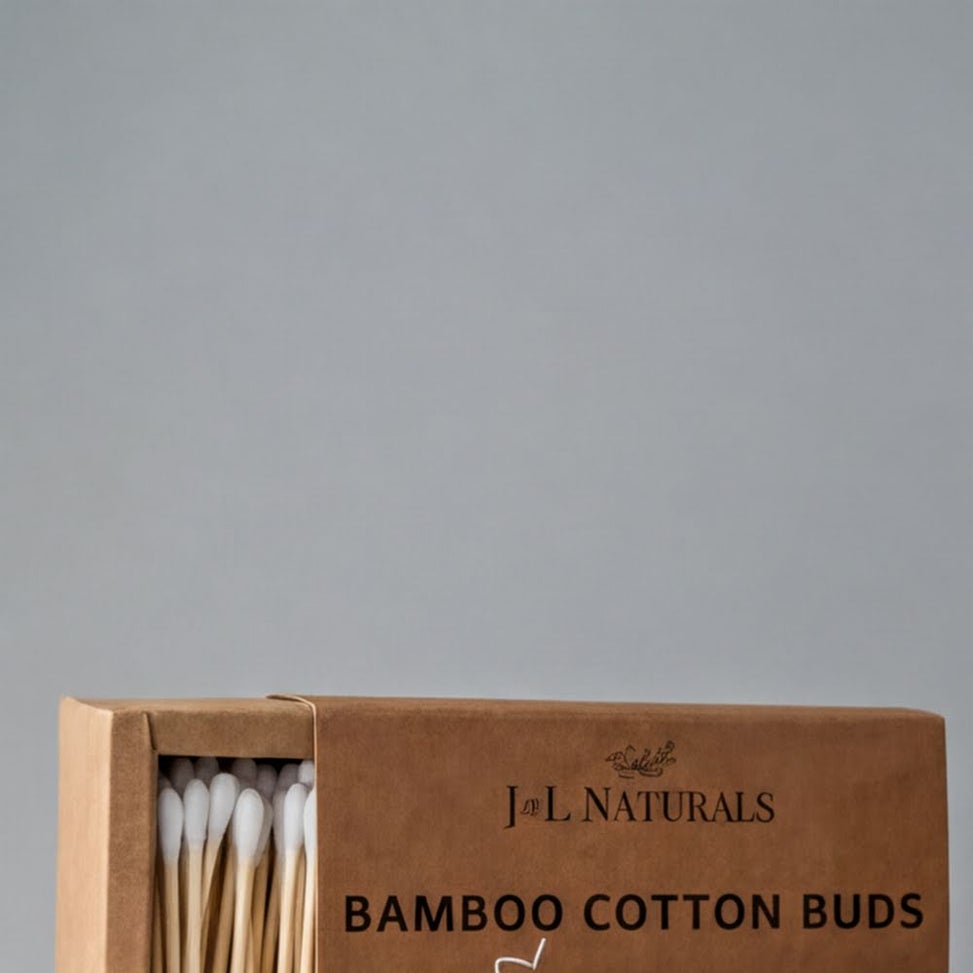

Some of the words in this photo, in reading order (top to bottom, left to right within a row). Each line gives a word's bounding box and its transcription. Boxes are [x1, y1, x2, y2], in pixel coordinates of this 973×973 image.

[581, 786, 775, 824] NATURALS
[344, 893, 564, 933] BAMBOO
[583, 893, 781, 932] COTTON
[802, 892, 924, 930] BUDS
